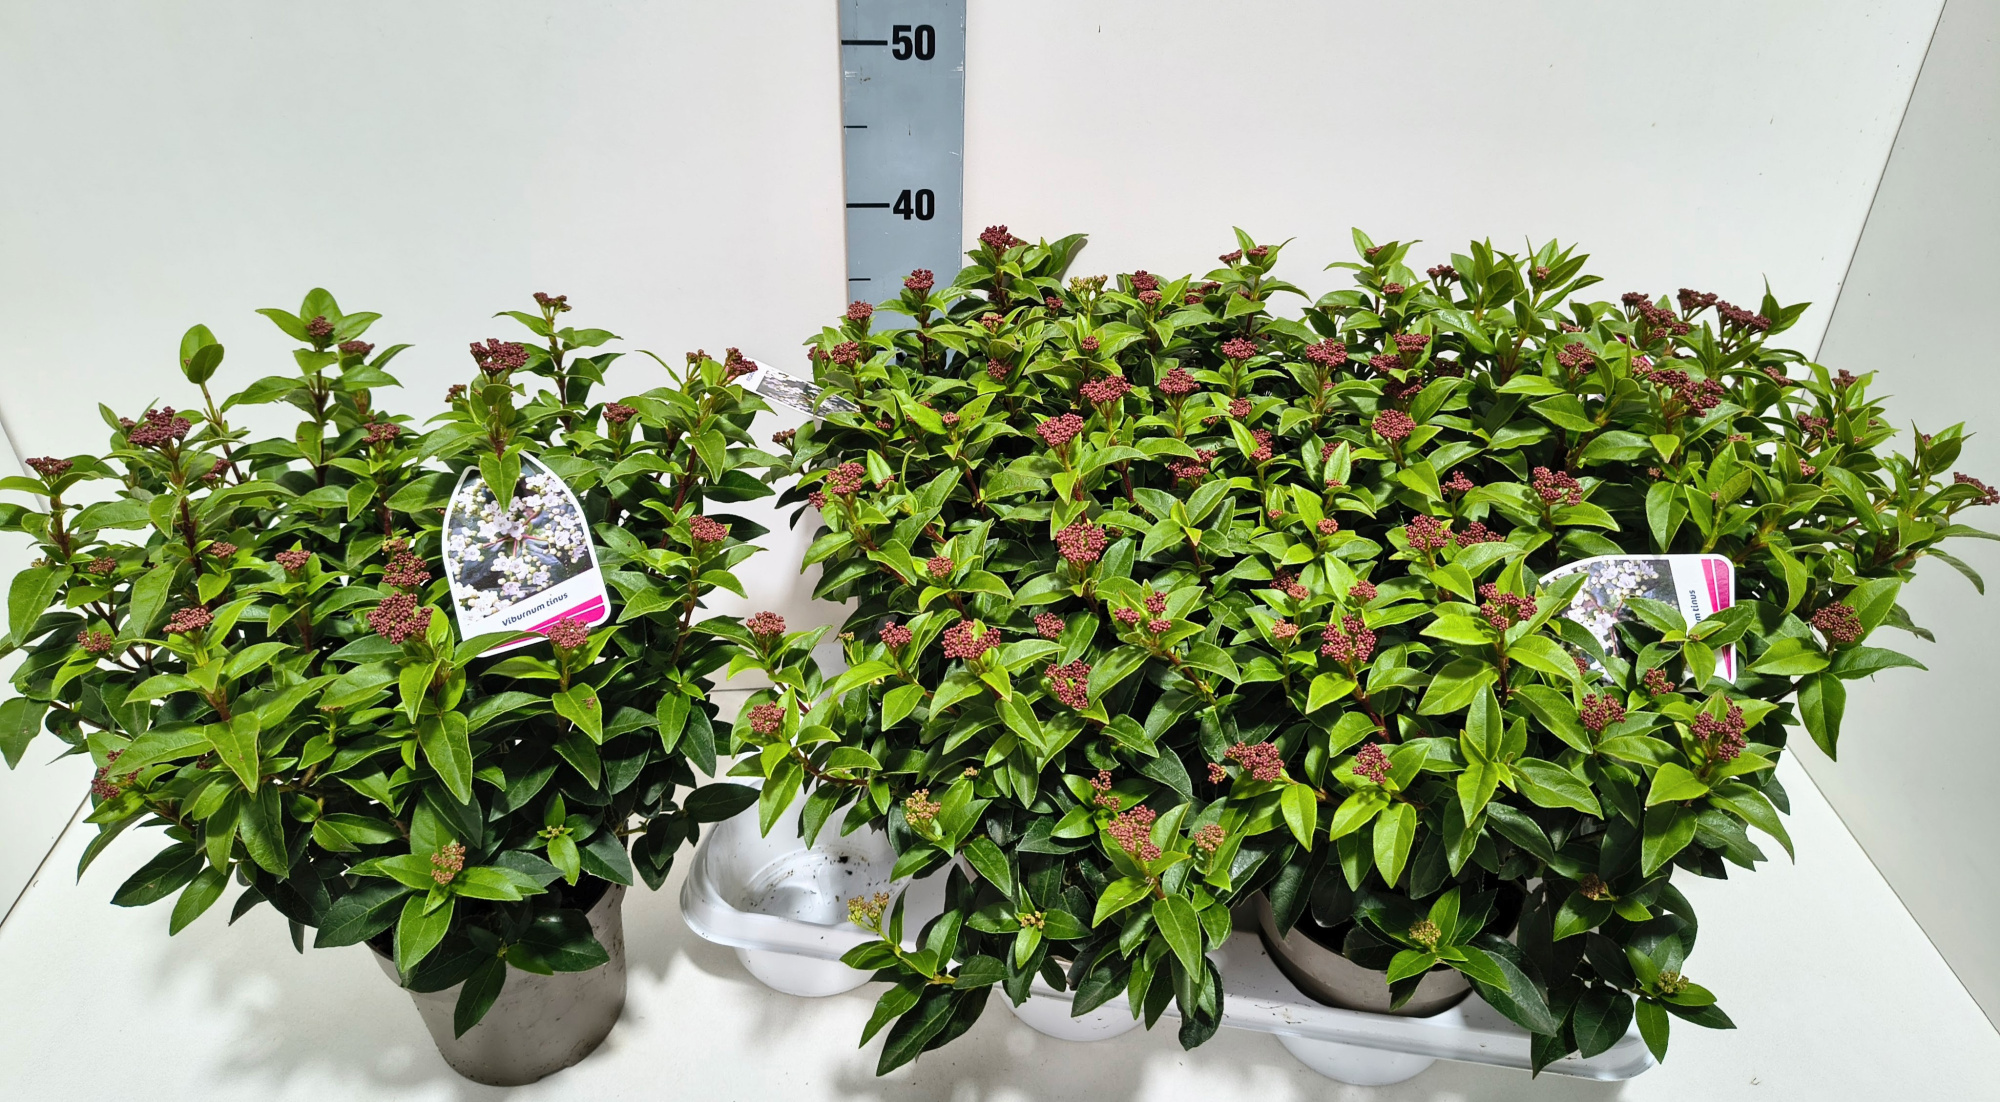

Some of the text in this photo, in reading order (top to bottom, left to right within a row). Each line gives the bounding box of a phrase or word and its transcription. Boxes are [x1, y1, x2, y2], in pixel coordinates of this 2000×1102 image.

[892, 24, 935, 61] 50
[893, 188, 935, 221] 40
[501, 592, 569, 627] Viburnum tinus
[1689, 589, 1700, 612] tinus
